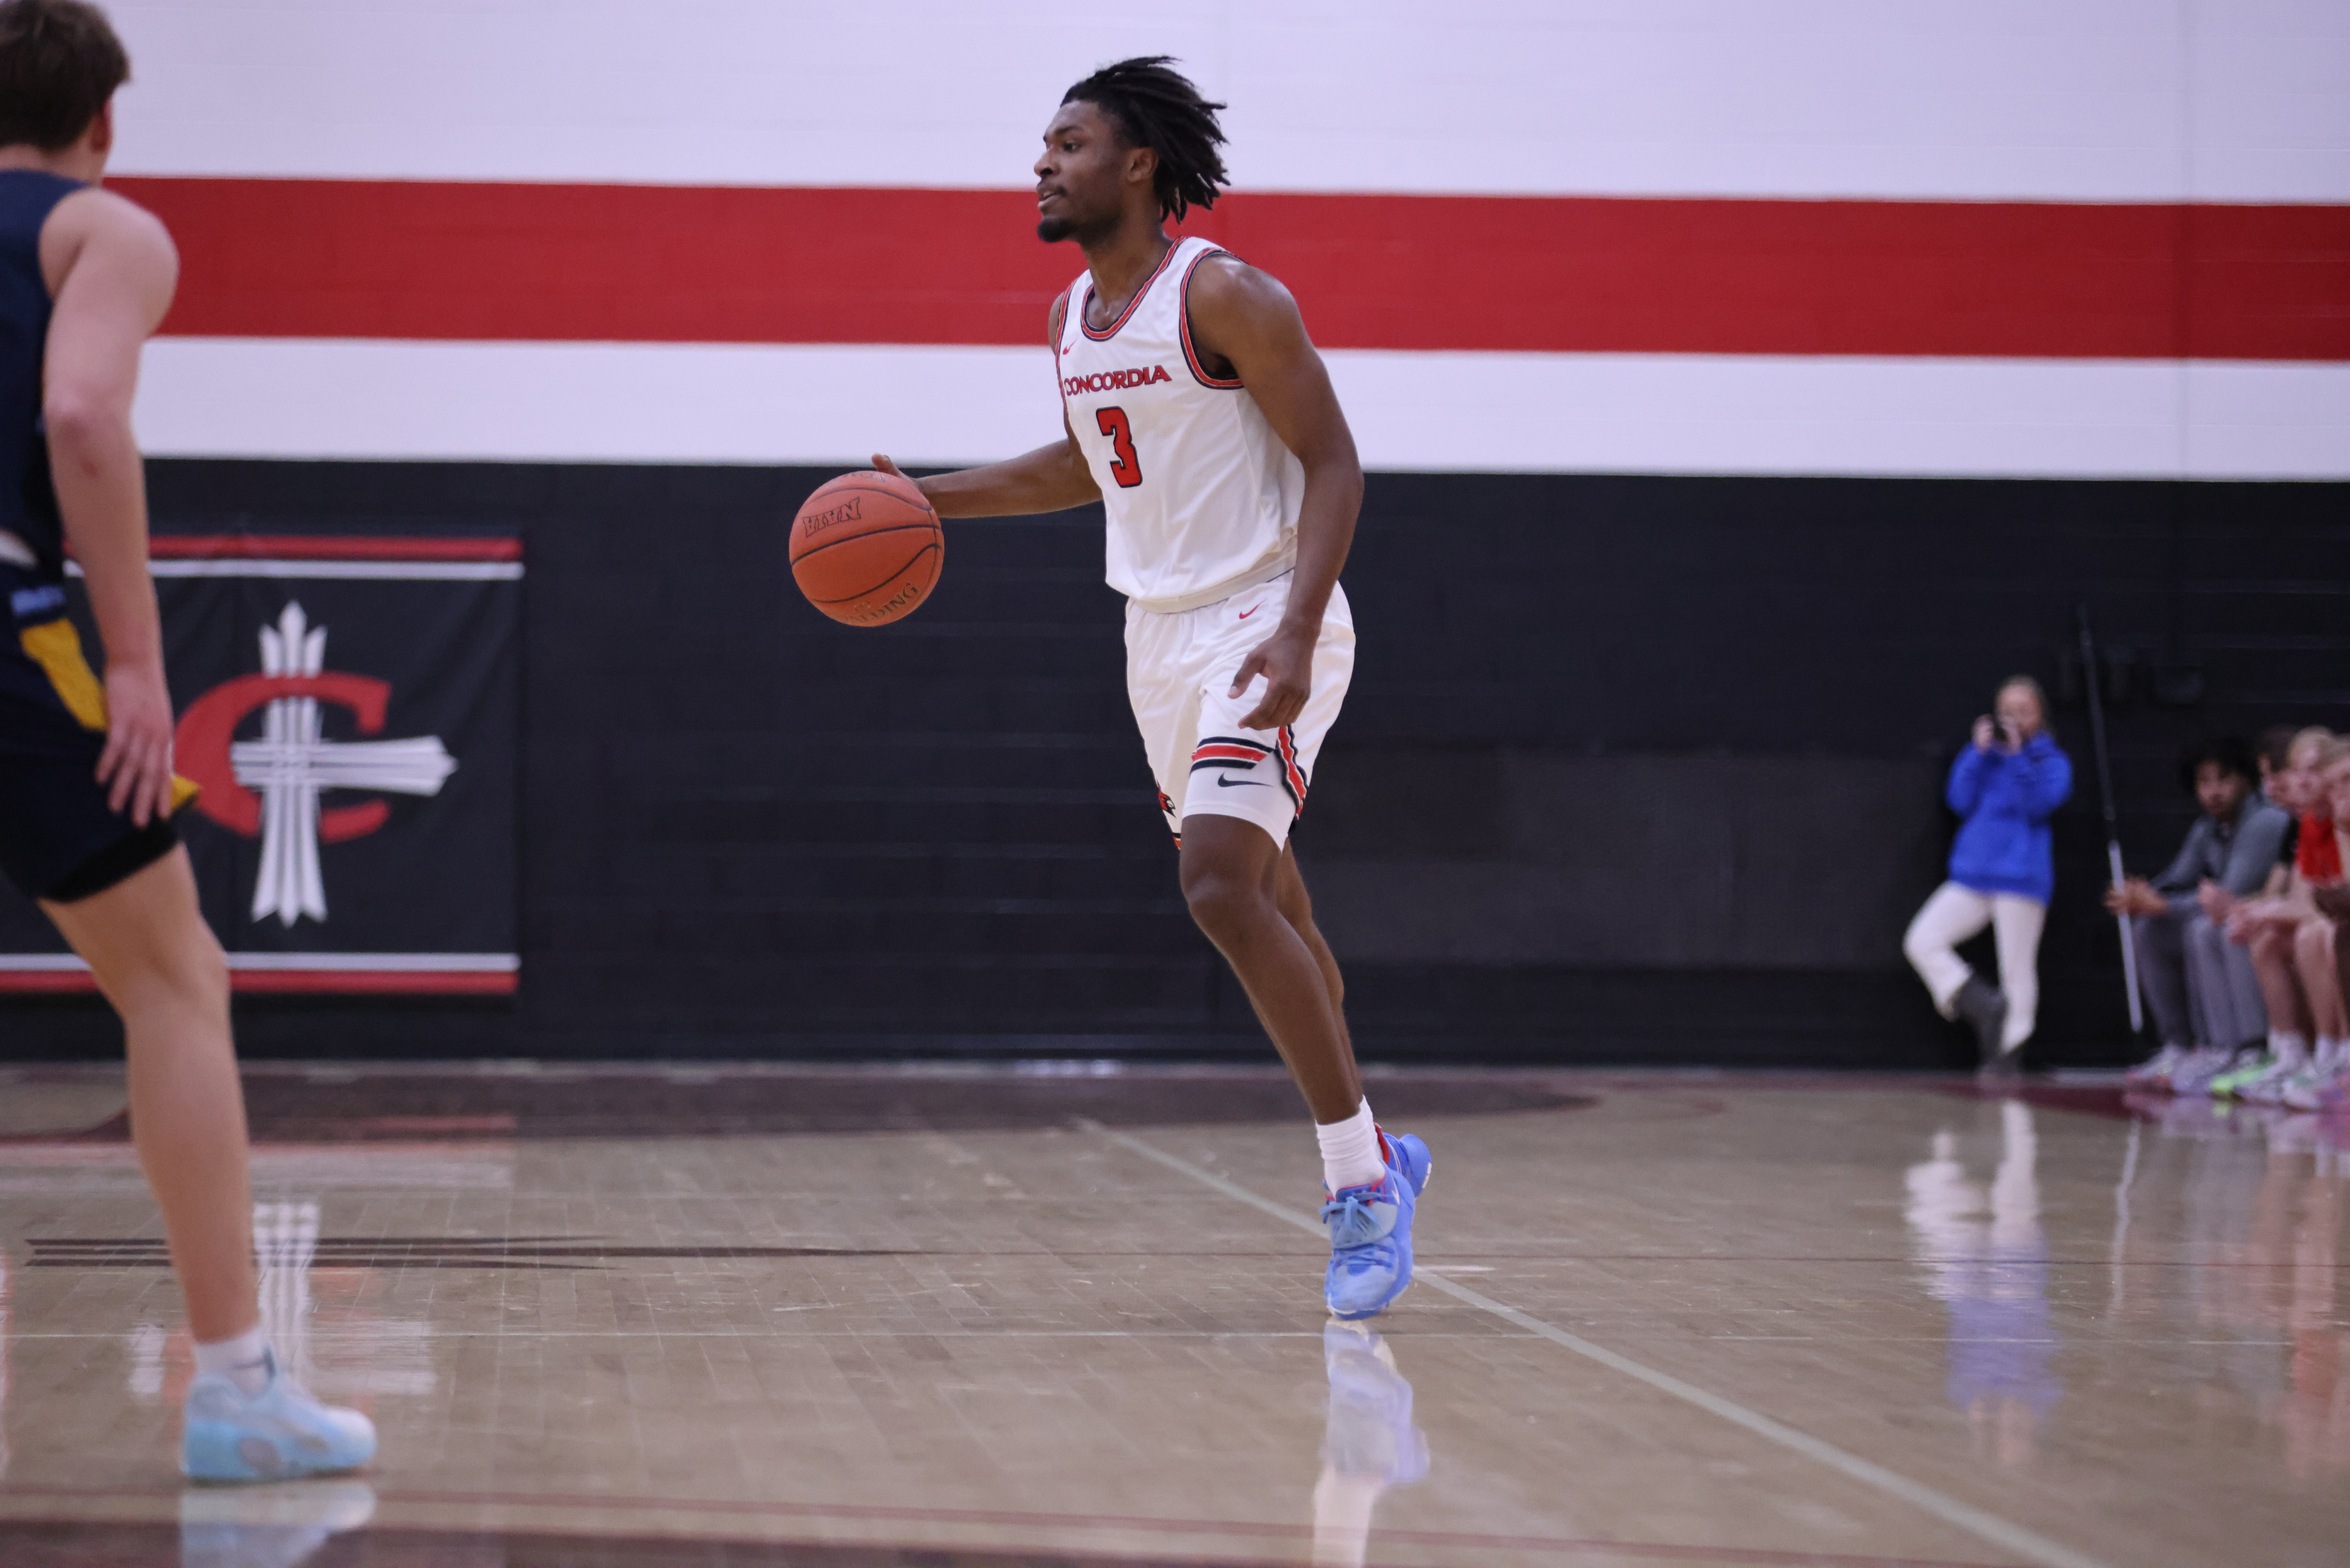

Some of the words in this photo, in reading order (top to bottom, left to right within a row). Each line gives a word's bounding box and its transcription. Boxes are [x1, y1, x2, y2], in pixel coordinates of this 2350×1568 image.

[1064, 365, 1172, 396] CONCORDIA
[1096, 406, 1143, 488] 3
[174, 672, 391, 842] C
